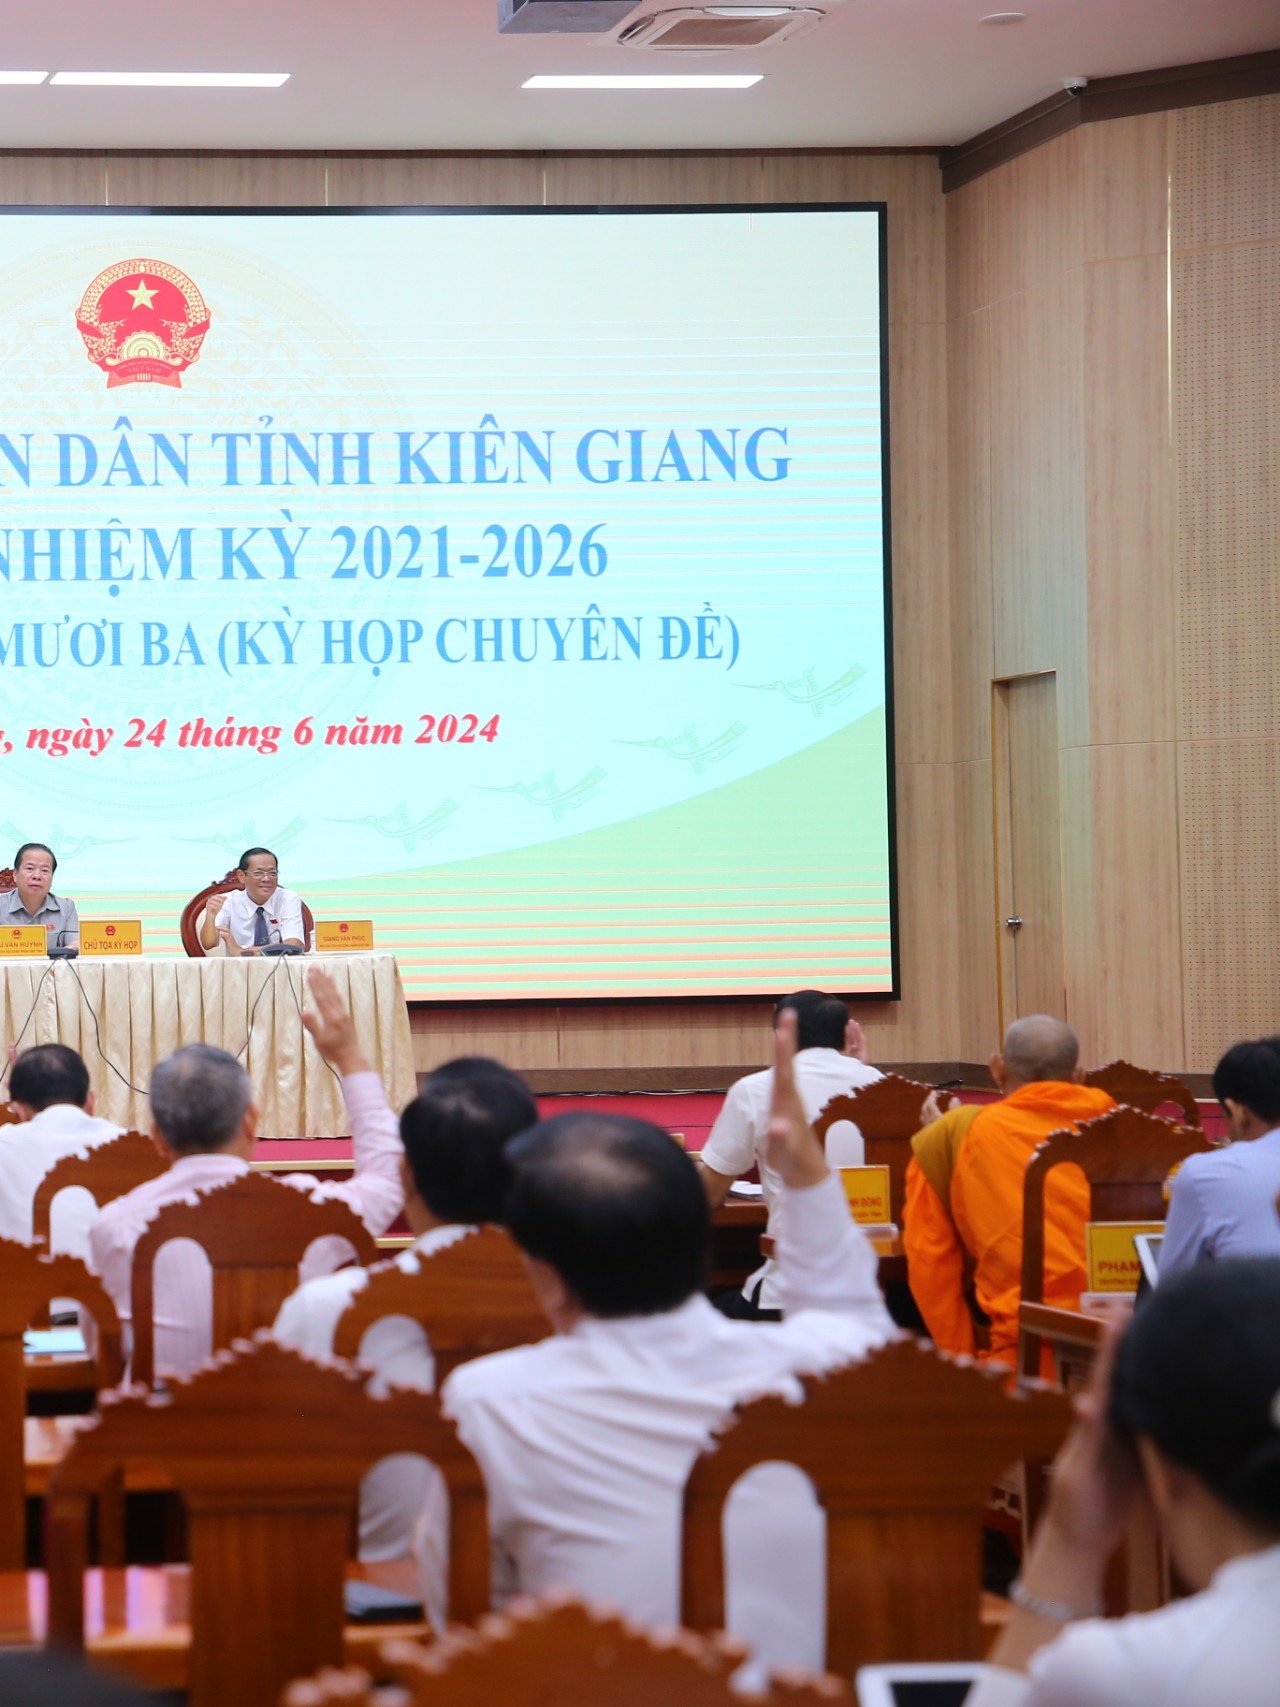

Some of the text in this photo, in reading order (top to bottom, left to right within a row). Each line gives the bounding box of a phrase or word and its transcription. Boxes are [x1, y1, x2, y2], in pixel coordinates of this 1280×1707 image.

[56, 415, 193, 487] DÂN
[211, 415, 373, 486] TỈNH
[395, 413, 556, 485] KIÊN
[576, 426, 792, 484] GIANG
[218, 508, 310, 580] KỲ
[331, 522, 609, 579] 2021-2026
[141, 622, 208, 666] BA
[218, 605, 305, 676] (KỲ
[322, 619, 425, 677] HỌP
[436, 603, 643, 664] CHUYÊN
[657, 601, 741, 671] ĐỀ)
[26, 718, 115, 758] ngày
[124, 718, 167, 748] 24
[177, 714, 282, 755] tháng
[293, 716, 313, 746] 6
[325, 716, 404, 746] năm
[415, 713, 501, 745] 2024
